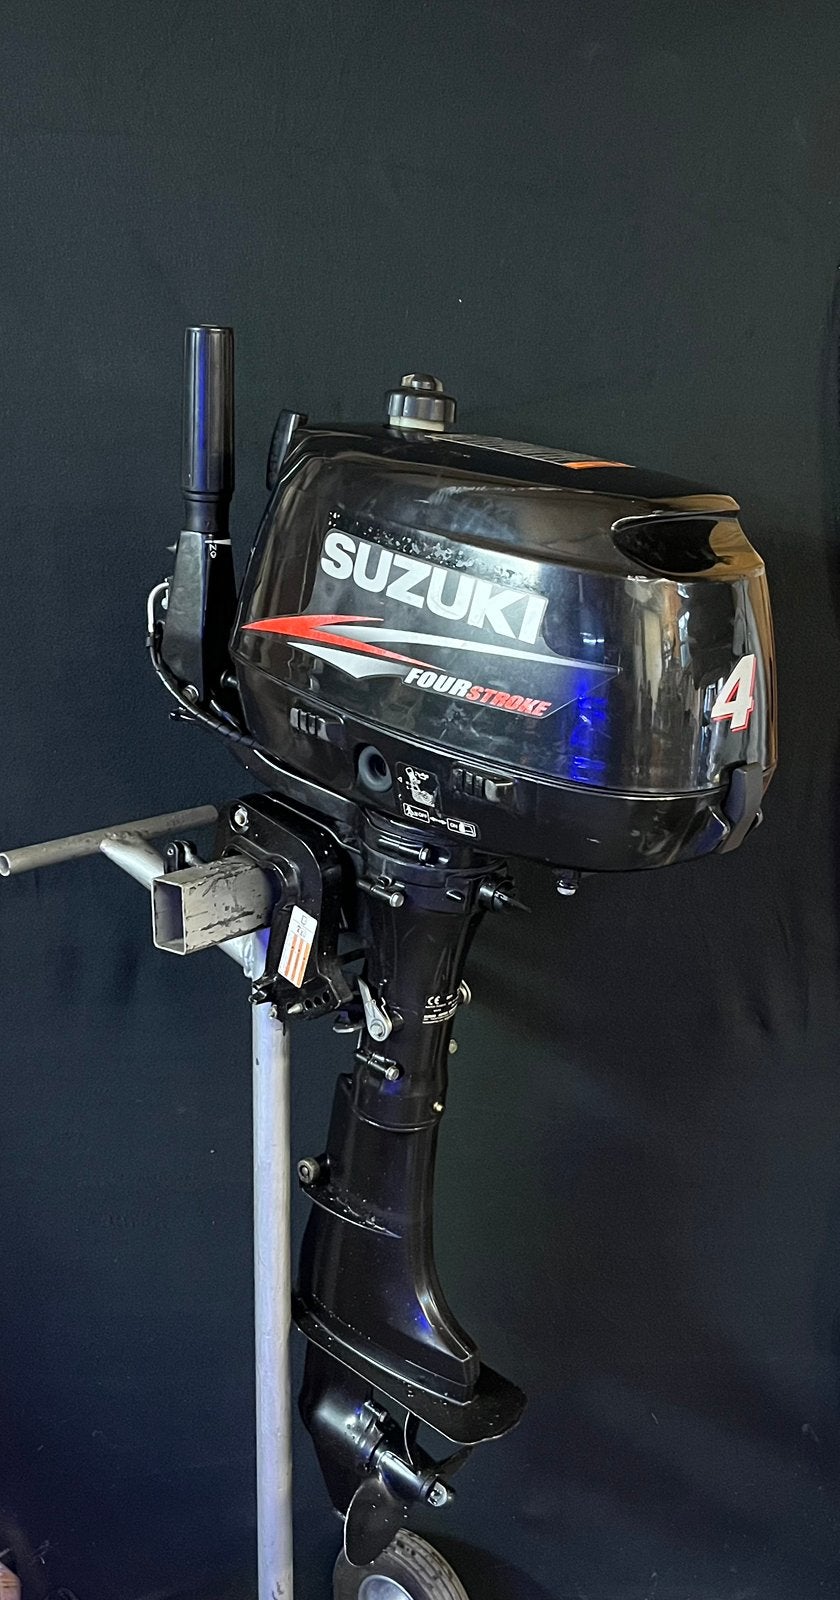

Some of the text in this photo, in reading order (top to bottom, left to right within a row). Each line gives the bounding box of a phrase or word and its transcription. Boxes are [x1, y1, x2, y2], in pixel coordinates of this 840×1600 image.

[320, 532, 547, 645] SUZUKI
[710, 653, 757, 733] 4
[427, 995, 441, 1006] CE
